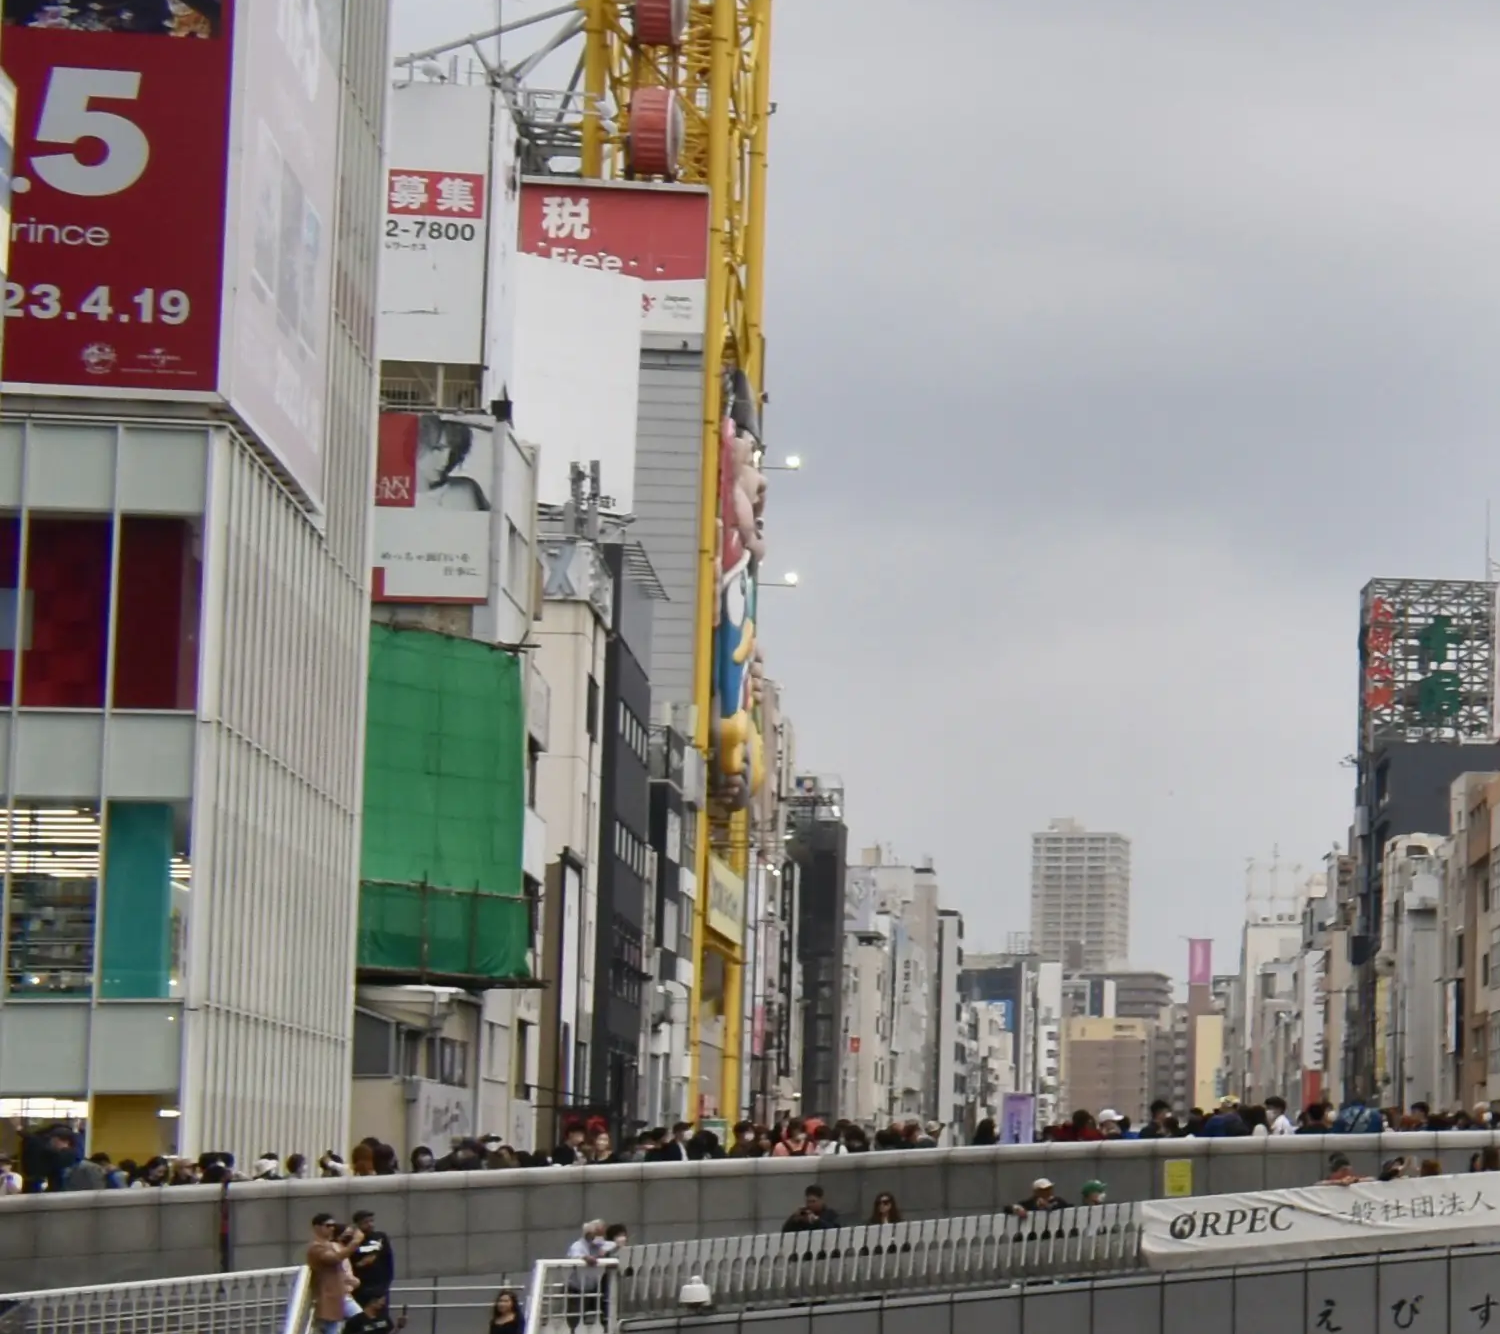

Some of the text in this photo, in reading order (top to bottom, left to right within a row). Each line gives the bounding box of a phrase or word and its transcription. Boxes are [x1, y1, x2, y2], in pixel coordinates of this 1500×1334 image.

[389, 174, 476, 213] 募集
[385, 218, 475, 243] 2-7800
[541, 196, 592, 240] 税
[1318, 1187, 1498, 1229] 一般社団法人
